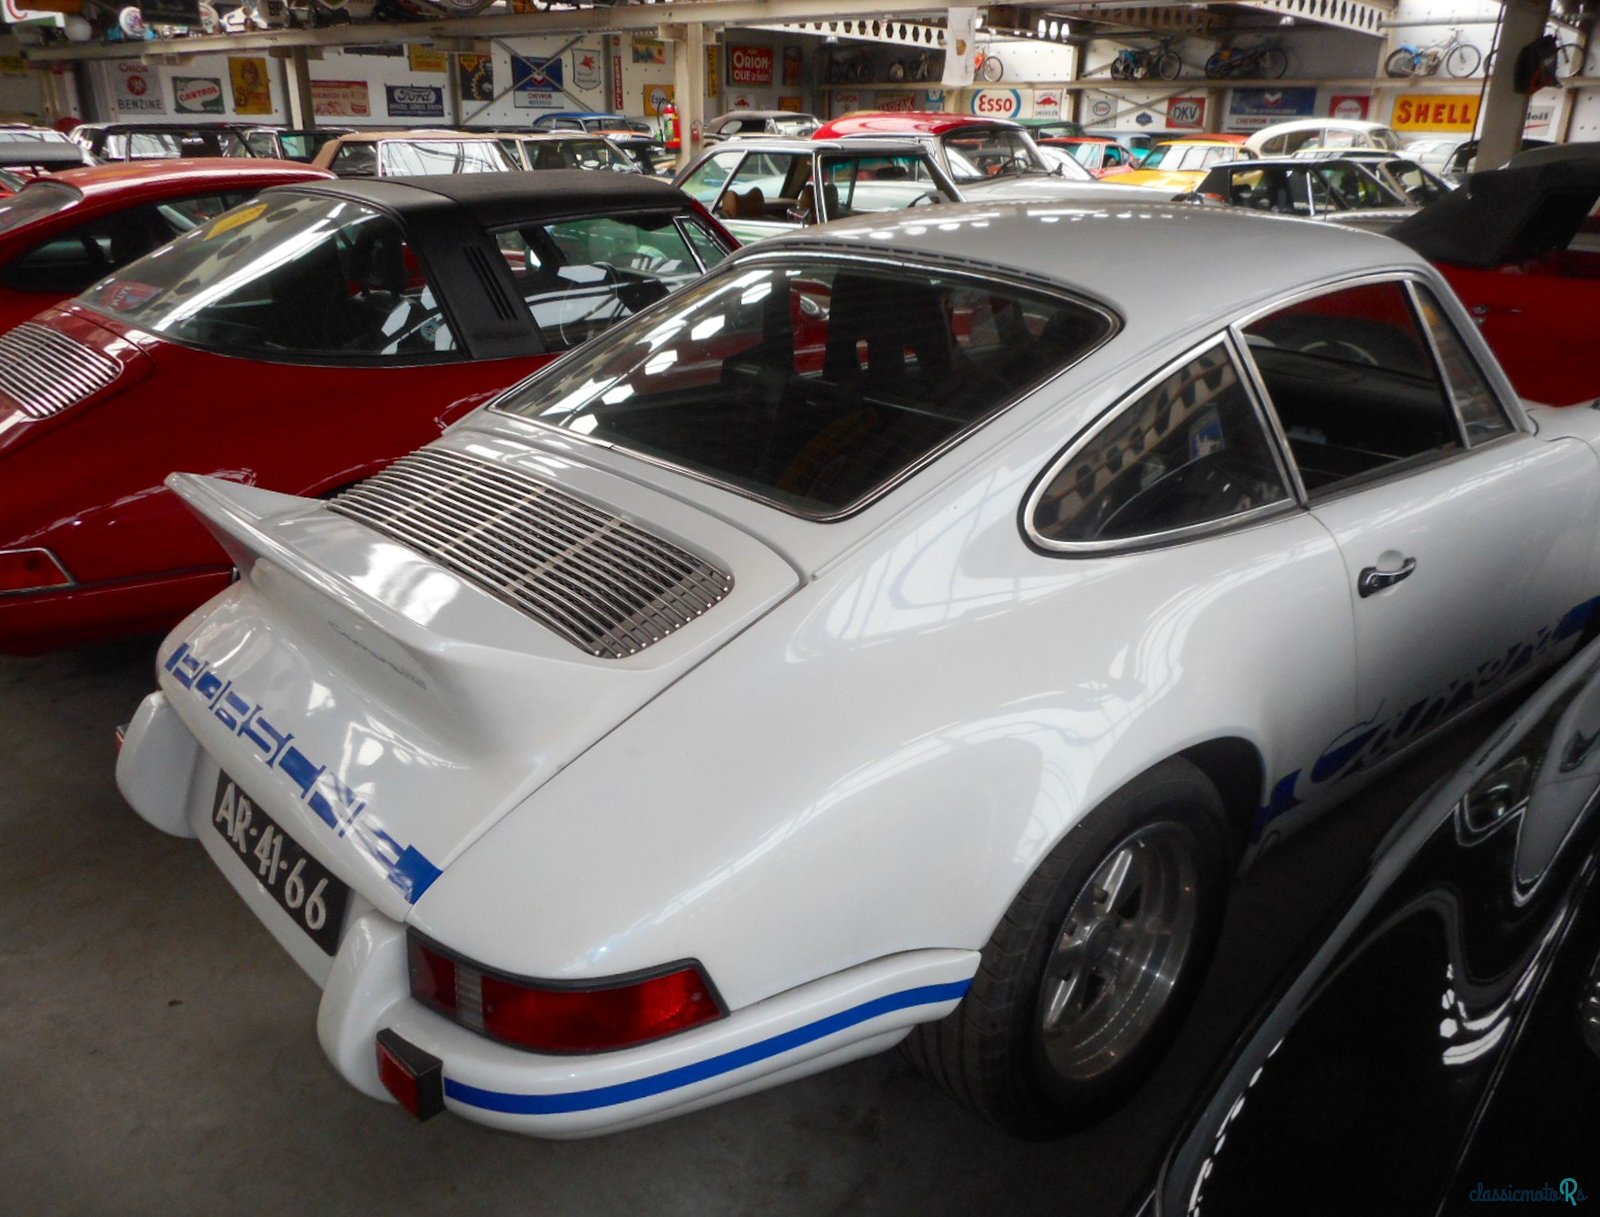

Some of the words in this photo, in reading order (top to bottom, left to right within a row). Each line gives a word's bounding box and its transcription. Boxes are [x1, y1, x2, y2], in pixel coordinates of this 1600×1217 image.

[179, 85, 218, 102] CASTROL
[397, 89, 431, 101] Ford
[118, 100, 163, 110] BENZINE
[1396, 100, 1471, 124] SHELL
[1172, 106, 1198, 120] DKV
